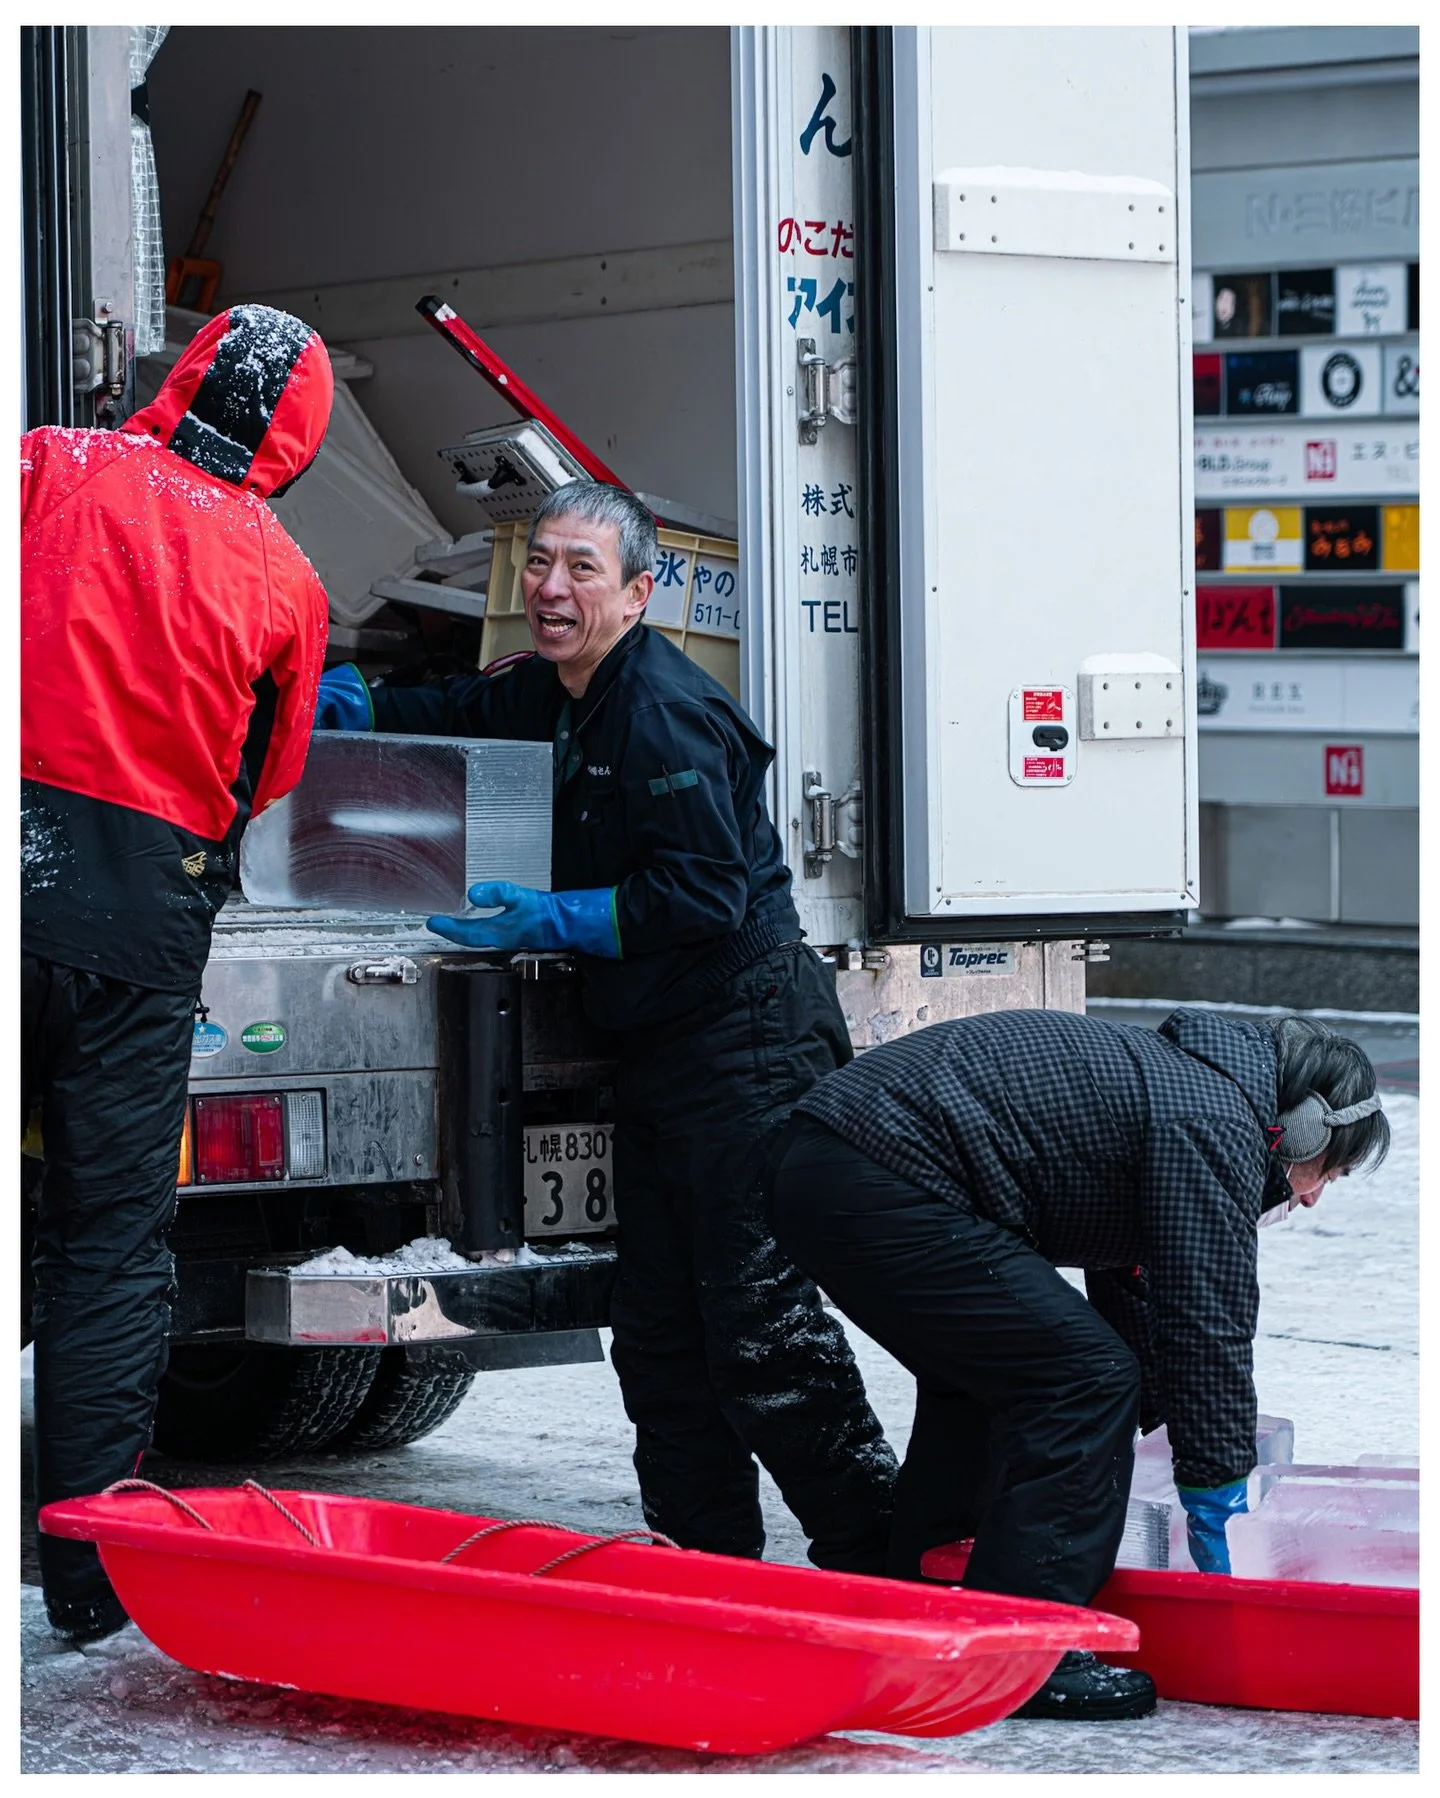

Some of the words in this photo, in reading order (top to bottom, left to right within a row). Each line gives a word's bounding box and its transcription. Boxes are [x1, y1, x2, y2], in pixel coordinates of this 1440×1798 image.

[800, 72, 852, 158] ん
[801, 483, 854, 519] 株式
[800, 544, 858, 577] 札幌市
[800, 600, 858, 633] TEL
[949, 947, 1009, 968] Toprec
